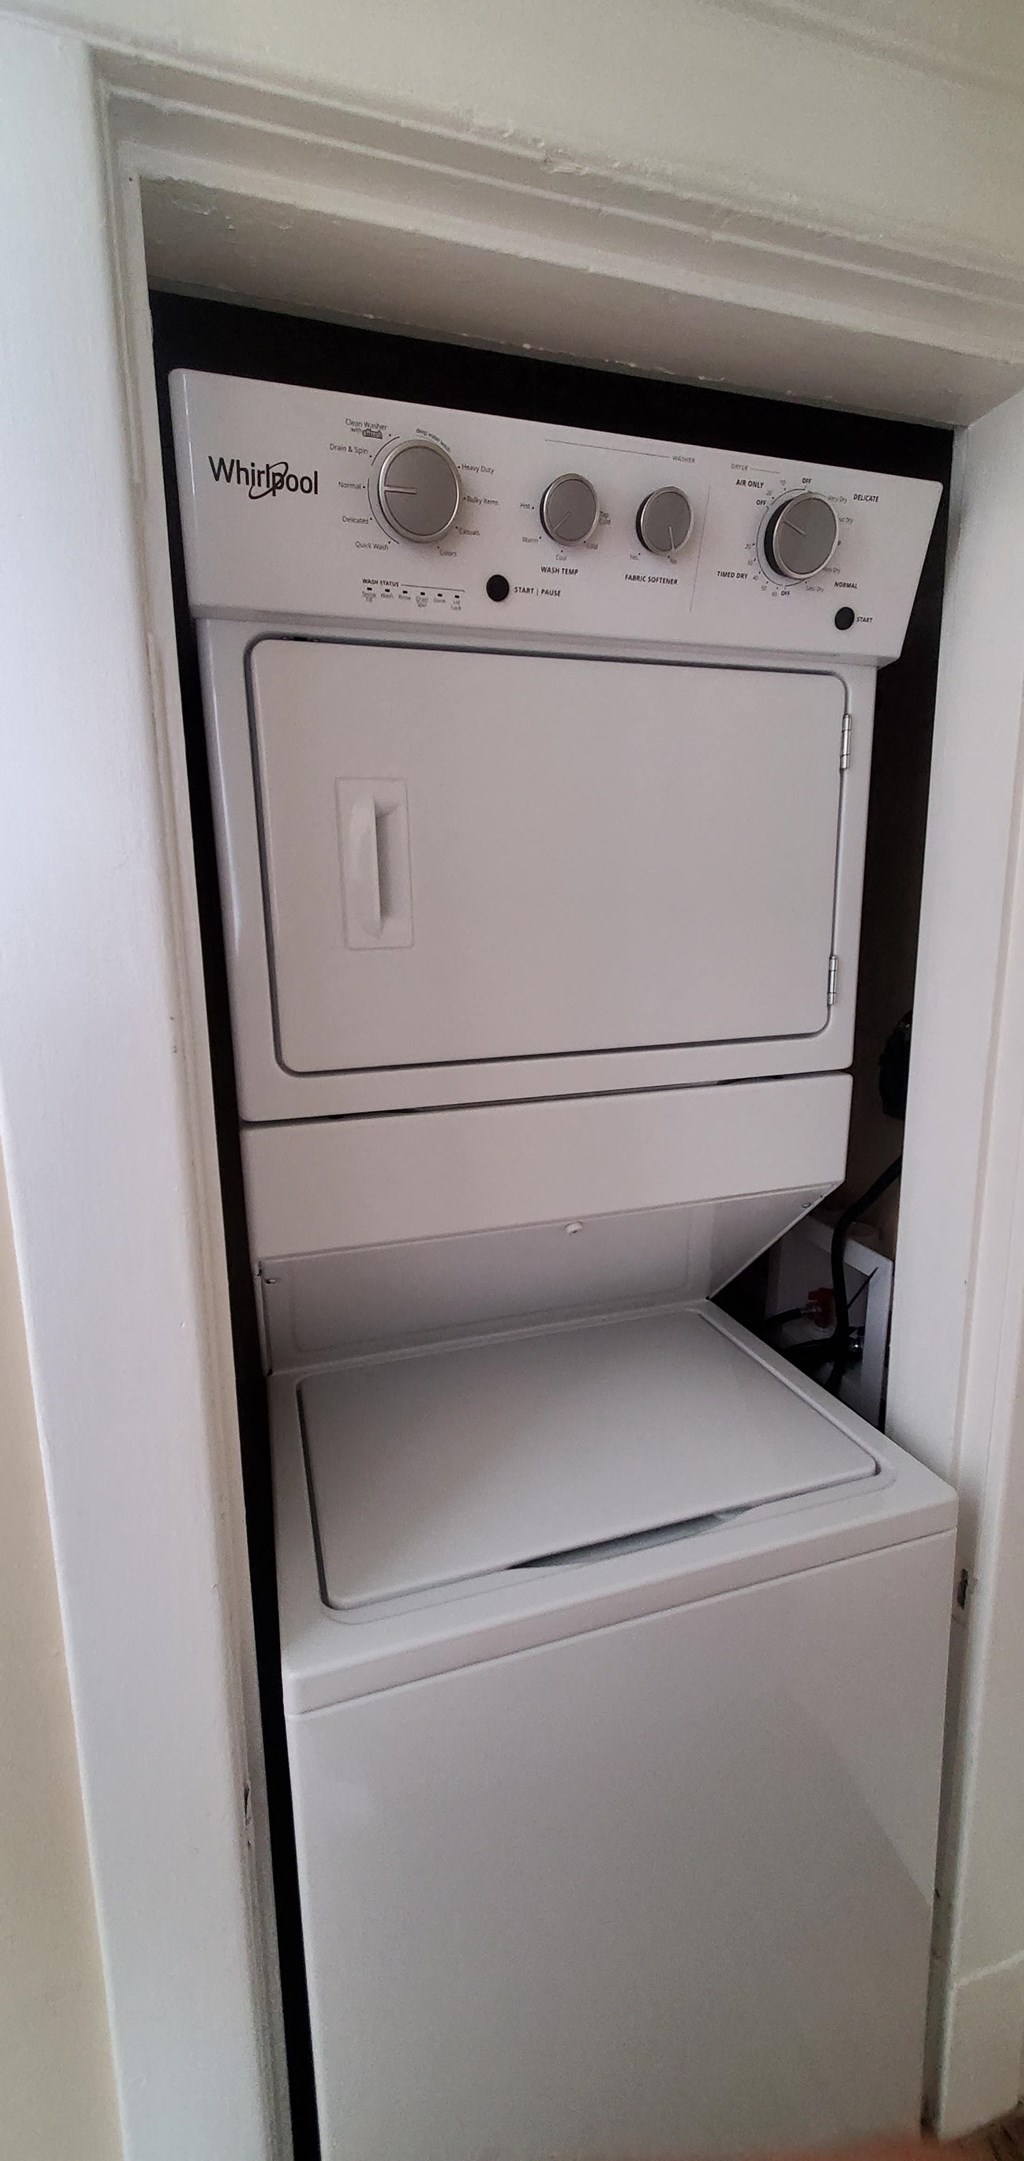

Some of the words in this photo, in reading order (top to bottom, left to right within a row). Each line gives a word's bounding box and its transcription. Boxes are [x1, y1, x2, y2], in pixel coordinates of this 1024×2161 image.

[345, 418, 363, 427] Clean
[363, 421, 387, 431] Washer
[329, 443, 347, 452] Drain
[354, 447, 369, 456] Spin
[461, 464, 480, 474] Heavy
[480, 466, 495, 476] Duty
[208, 455, 318, 500] Whirlpool
[338, 481, 362, 490] Normal
[736, 479, 748, 487] AIR
[748, 481, 765, 489] ONLY
[467, 495, 482, 505] Bulky
[483, 498, 499, 506] Items
[853, 493, 880, 503] DELICATE
[342, 515, 369, 525] Delicates
[355, 540, 373, 550] Quick
[373, 543, 389, 551] Wash
[540, 565, 560, 575] WASH
[561, 567, 579, 576] TEMP
[717, 570, 735, 578] TIMED
[735, 572, 748, 580] DRY
[379, 580, 399, 588] STATUS
[624, 573, 647, 583] FABRIC
[647, 575, 678, 586] SOFTENER
[833, 581, 858, 590] NORMAL
[514, 586, 534, 595] START
[540, 588, 561, 597] PAUSE
